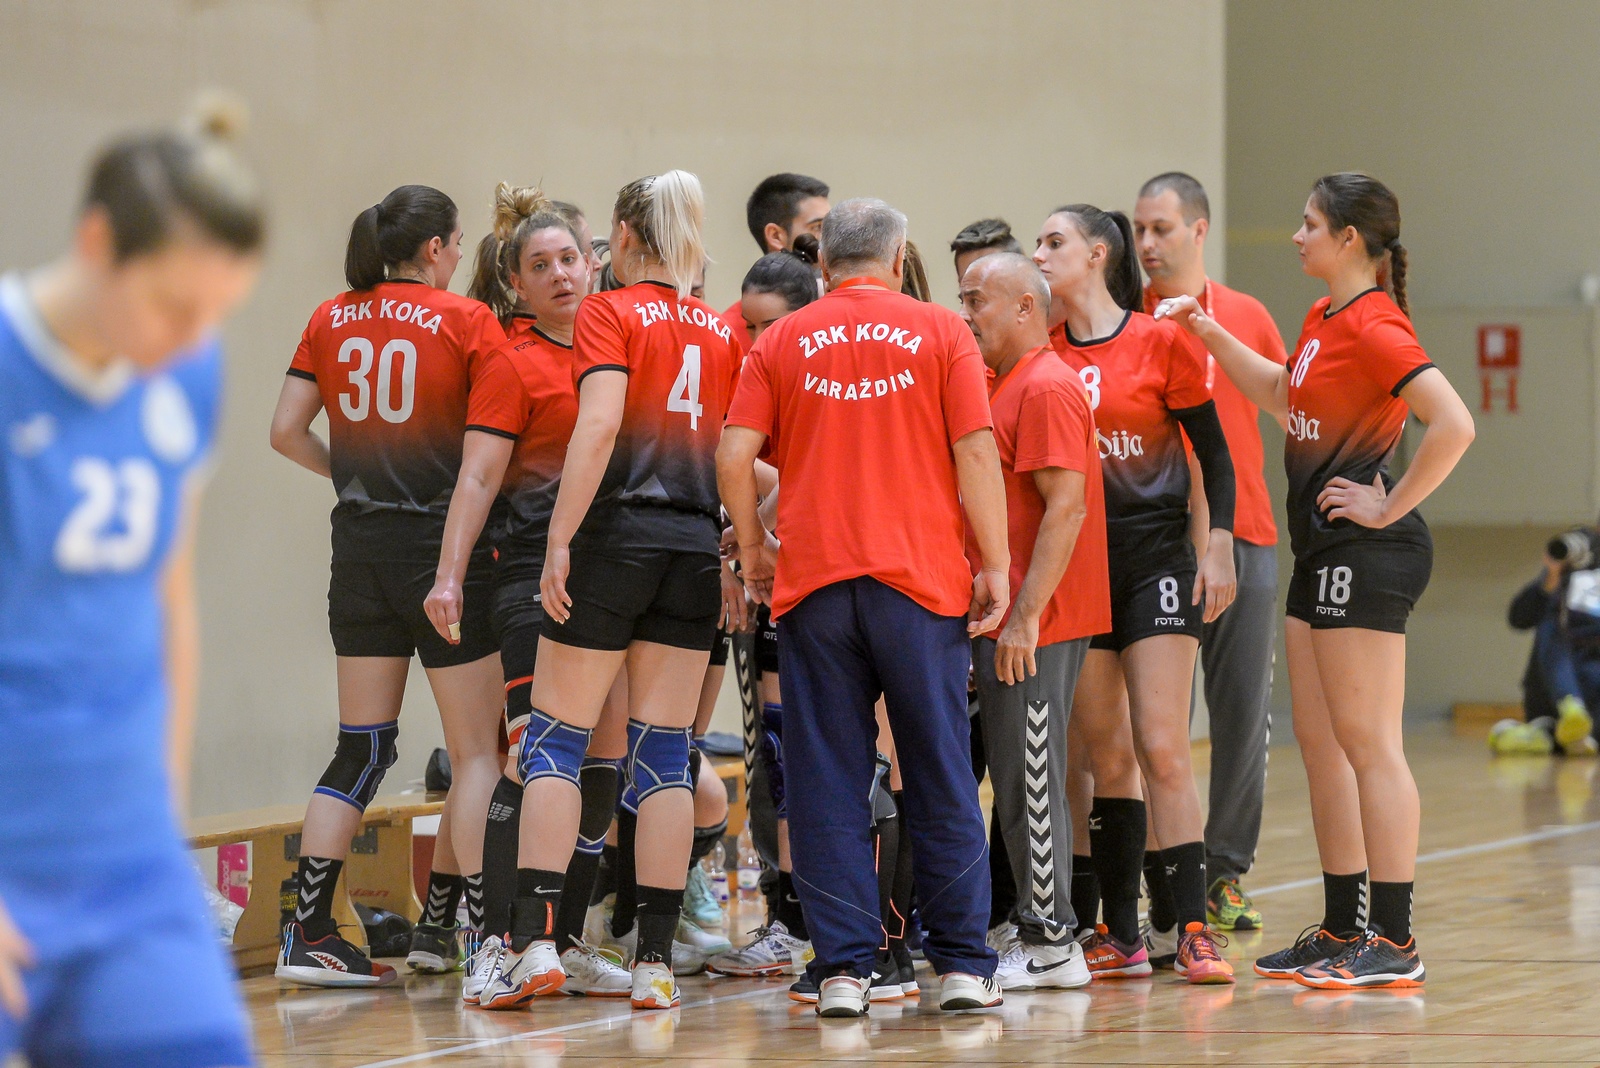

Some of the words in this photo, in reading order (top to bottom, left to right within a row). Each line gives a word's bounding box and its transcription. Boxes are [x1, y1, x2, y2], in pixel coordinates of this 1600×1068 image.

[330, 299, 373, 329] ŽRK
[379, 298, 442, 335] KOKA
[633, 300, 674, 328] ŽRK
[676, 303, 732, 345] KOKA
[798, 324, 849, 358] ŽRK
[855, 322, 923, 355] KOKA
[337, 336, 417, 423] 30
[1290, 338, 1320, 388] 18
[667, 344, 703, 431] 4
[803, 368, 915, 400] VARAŽDIN
[1079, 365, 1101, 411] 8
[1158, 576, 1180, 614] 8
[1317, 566, 1352, 604] 18
[1155, 617, 1185, 626] FOTEX
[1316, 606, 1346, 617] FOTEX
